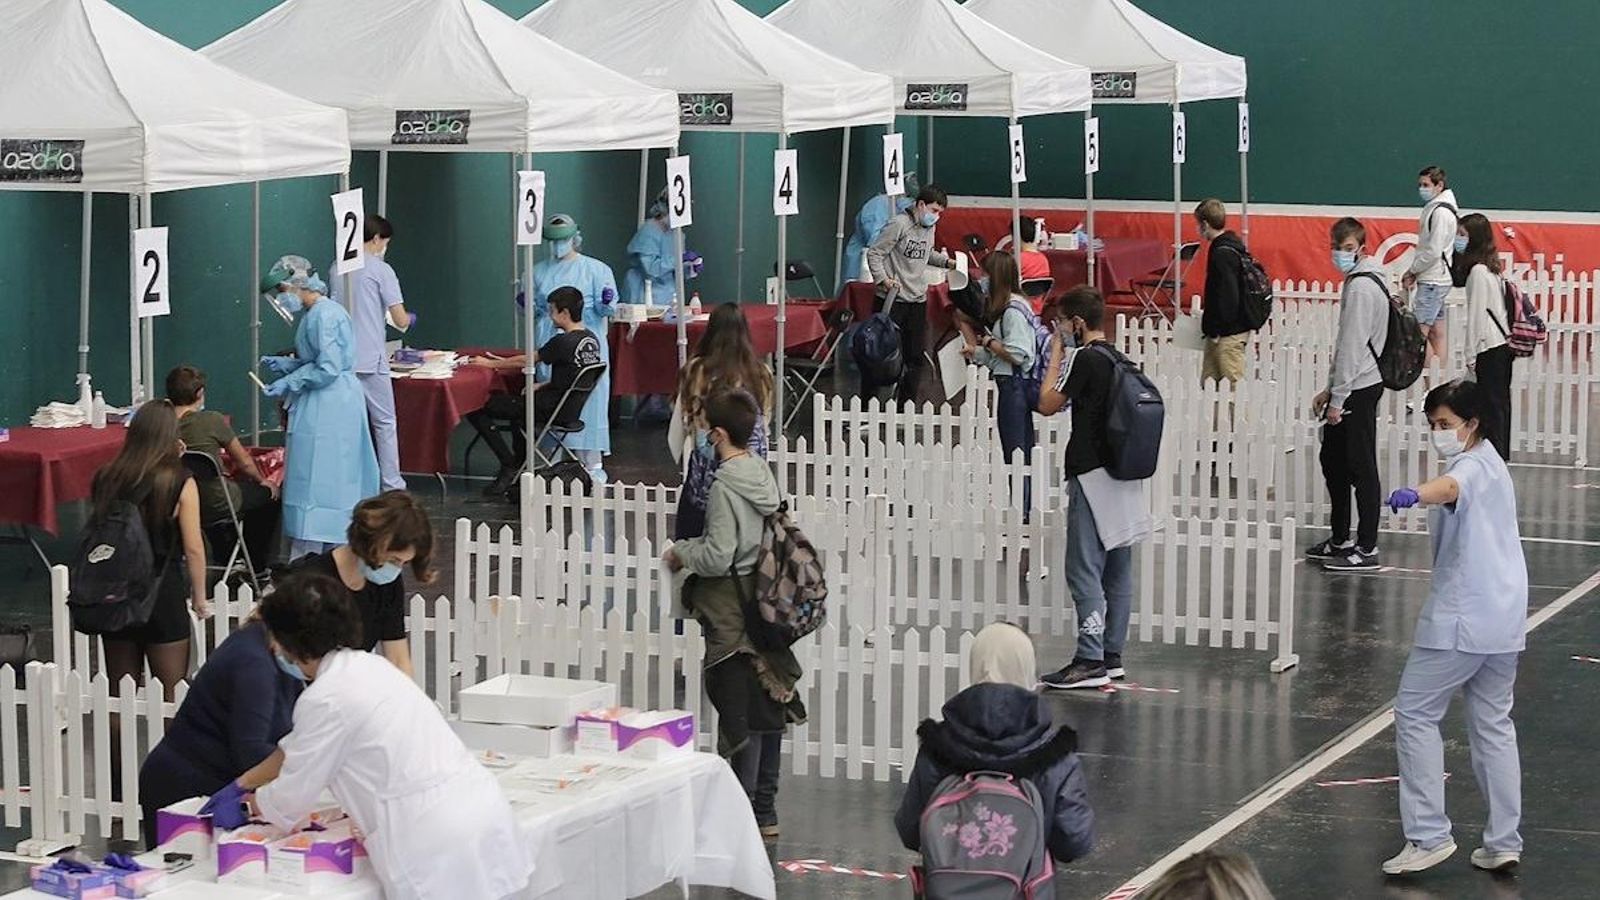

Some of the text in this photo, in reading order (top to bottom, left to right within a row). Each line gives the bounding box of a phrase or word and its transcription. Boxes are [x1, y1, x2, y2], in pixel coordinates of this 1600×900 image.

[1089, 132, 1097, 165] 5
[1176, 124, 1183, 156] 6
[1241, 115, 1247, 145] 6
[887, 149, 900, 186] 4
[1014, 139, 1022, 175] 5
[674, 175, 686, 217] 3
[778, 166, 793, 205] 4
[526, 188, 538, 234] 3
[343, 211, 358, 261] 2
[143, 250, 160, 304] 2
